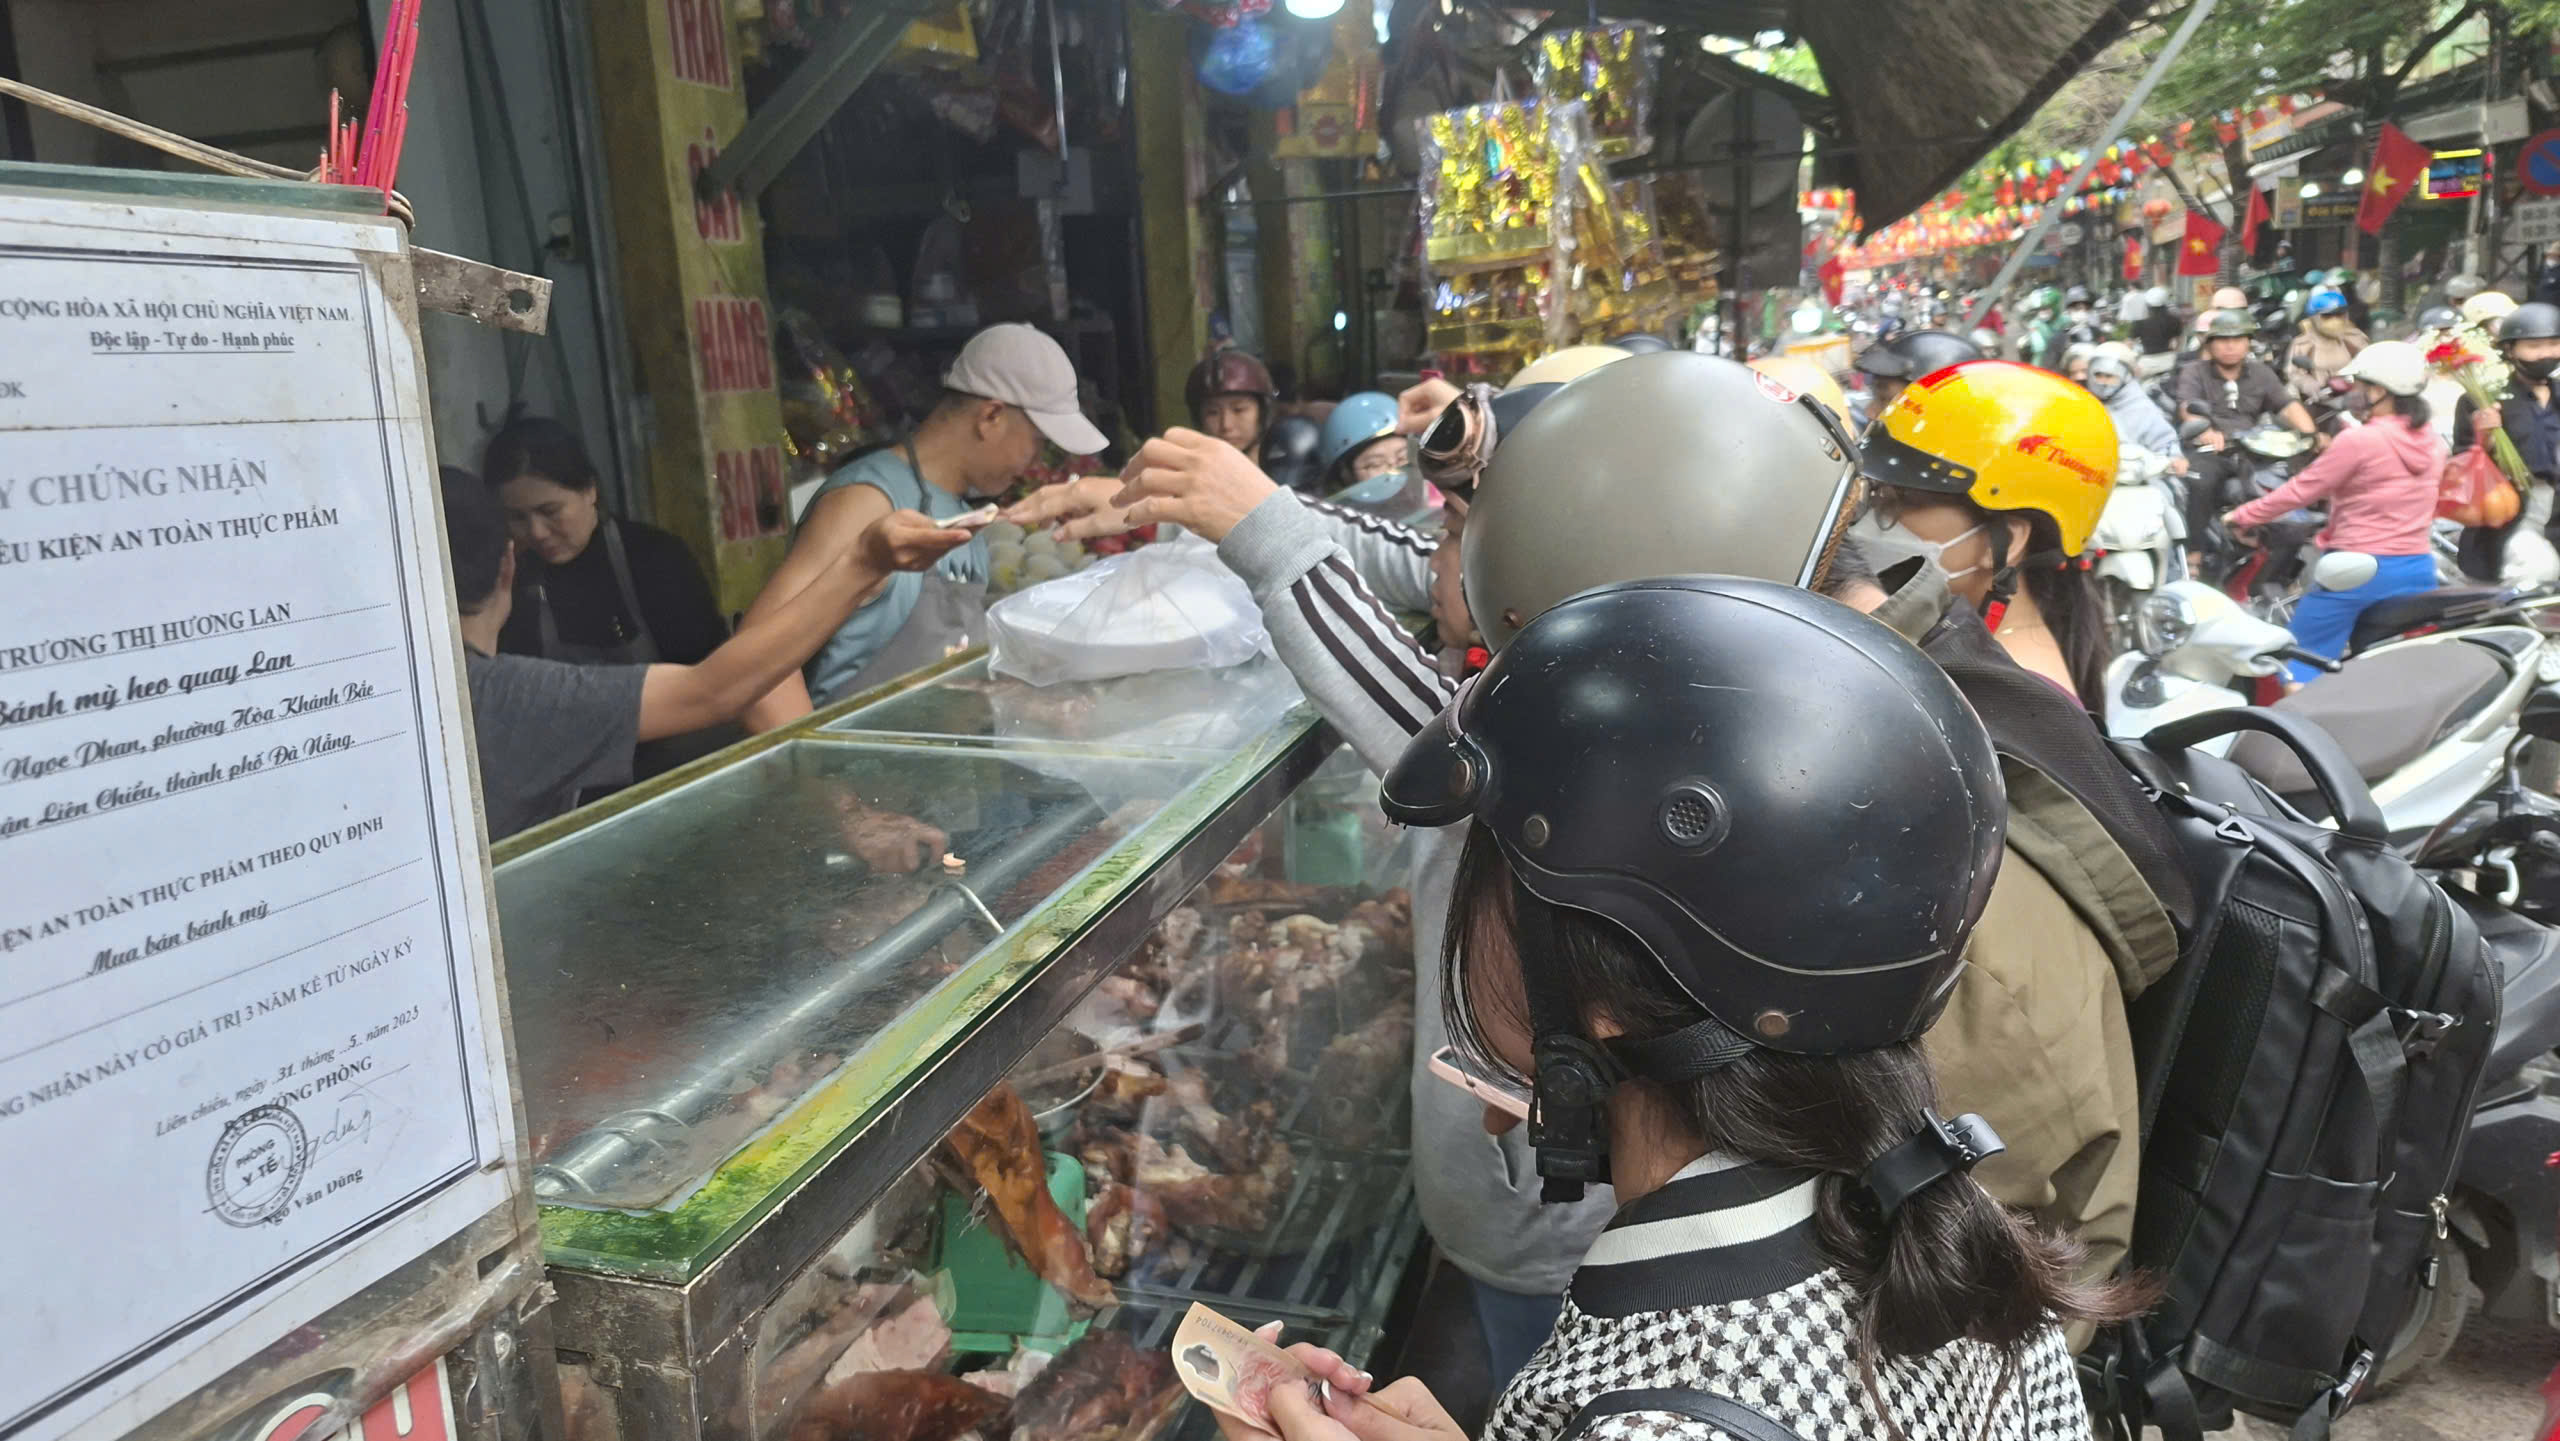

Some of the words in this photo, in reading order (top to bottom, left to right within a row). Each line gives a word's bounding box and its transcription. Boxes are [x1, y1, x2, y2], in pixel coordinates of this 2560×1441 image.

[1, 297, 60, 320] CỘNG
[66, 297, 109, 318] HÒA
[114, 299, 140, 318] XÃ
[145, 300, 177, 322] HỘI
[183, 299, 219, 319] CHỦ
[223, 301, 276, 319] NGHĨA
[280, 304, 313, 323] VIỆT
[318, 306, 350, 321] NAM
[91, 331, 122, 350] Độc
[126, 331, 150, 350] lập
[163, 332, 187, 349] Tự
[191, 332, 208, 346] do
[223, 332, 259, 349] Hạnh
[264, 332, 295, 350] phúc
[29, 463, 168, 506] CHỨNG
[177, 458, 268, 495] NHẬN
[38, 533, 104, 561] KIỆN
[111, 529, 143, 552] AN
[149, 519, 213, 547] TOÀN
[217, 512, 278, 539] THỰC
[283, 504, 339, 532] PHẨM
[112, 624, 157, 650] THỊ
[161, 614, 244, 642] HƯƠNG
[250, 602, 292, 627] LAN
[127, 675, 170, 700] heo
[178, 664, 241, 695] quay
[245, 650, 295, 677] Lan
[231, 706, 276, 729] Hòa
[279, 687, 340, 718] Khánh
[37, 802, 89, 826] Liên
[166, 763, 224, 793] thành
[229, 752, 265, 782] phố
[270, 745, 298, 766] Đà
[40, 914, 69, 939] AN
[75, 895, 134, 926] TOÀN
[139, 876, 195, 907] THỰC
[258, 842, 306, 869] THEO
[310, 829, 342, 854] QUY
[347, 816, 384, 840] ĐỊNH
[87, 948, 140, 977] Mua
[145, 932, 182, 956] bán
[187, 909, 236, 941] bánh
[29, 1071, 92, 1108] NHẬN
[96, 1050, 139, 1081] NÀY
[143, 1034, 172, 1061] CÓ
[175, 1019, 209, 1048] GIÁ
[213, 1009, 243, 1034] TRỊ
[245, 1005, 255, 1021] 3
[257, 988, 298, 1017] NĂM
[325, 963, 347, 988] TỪ
[349, 948, 392, 978] NGÀY
[315, 1055, 373, 1092] PHÒNG
